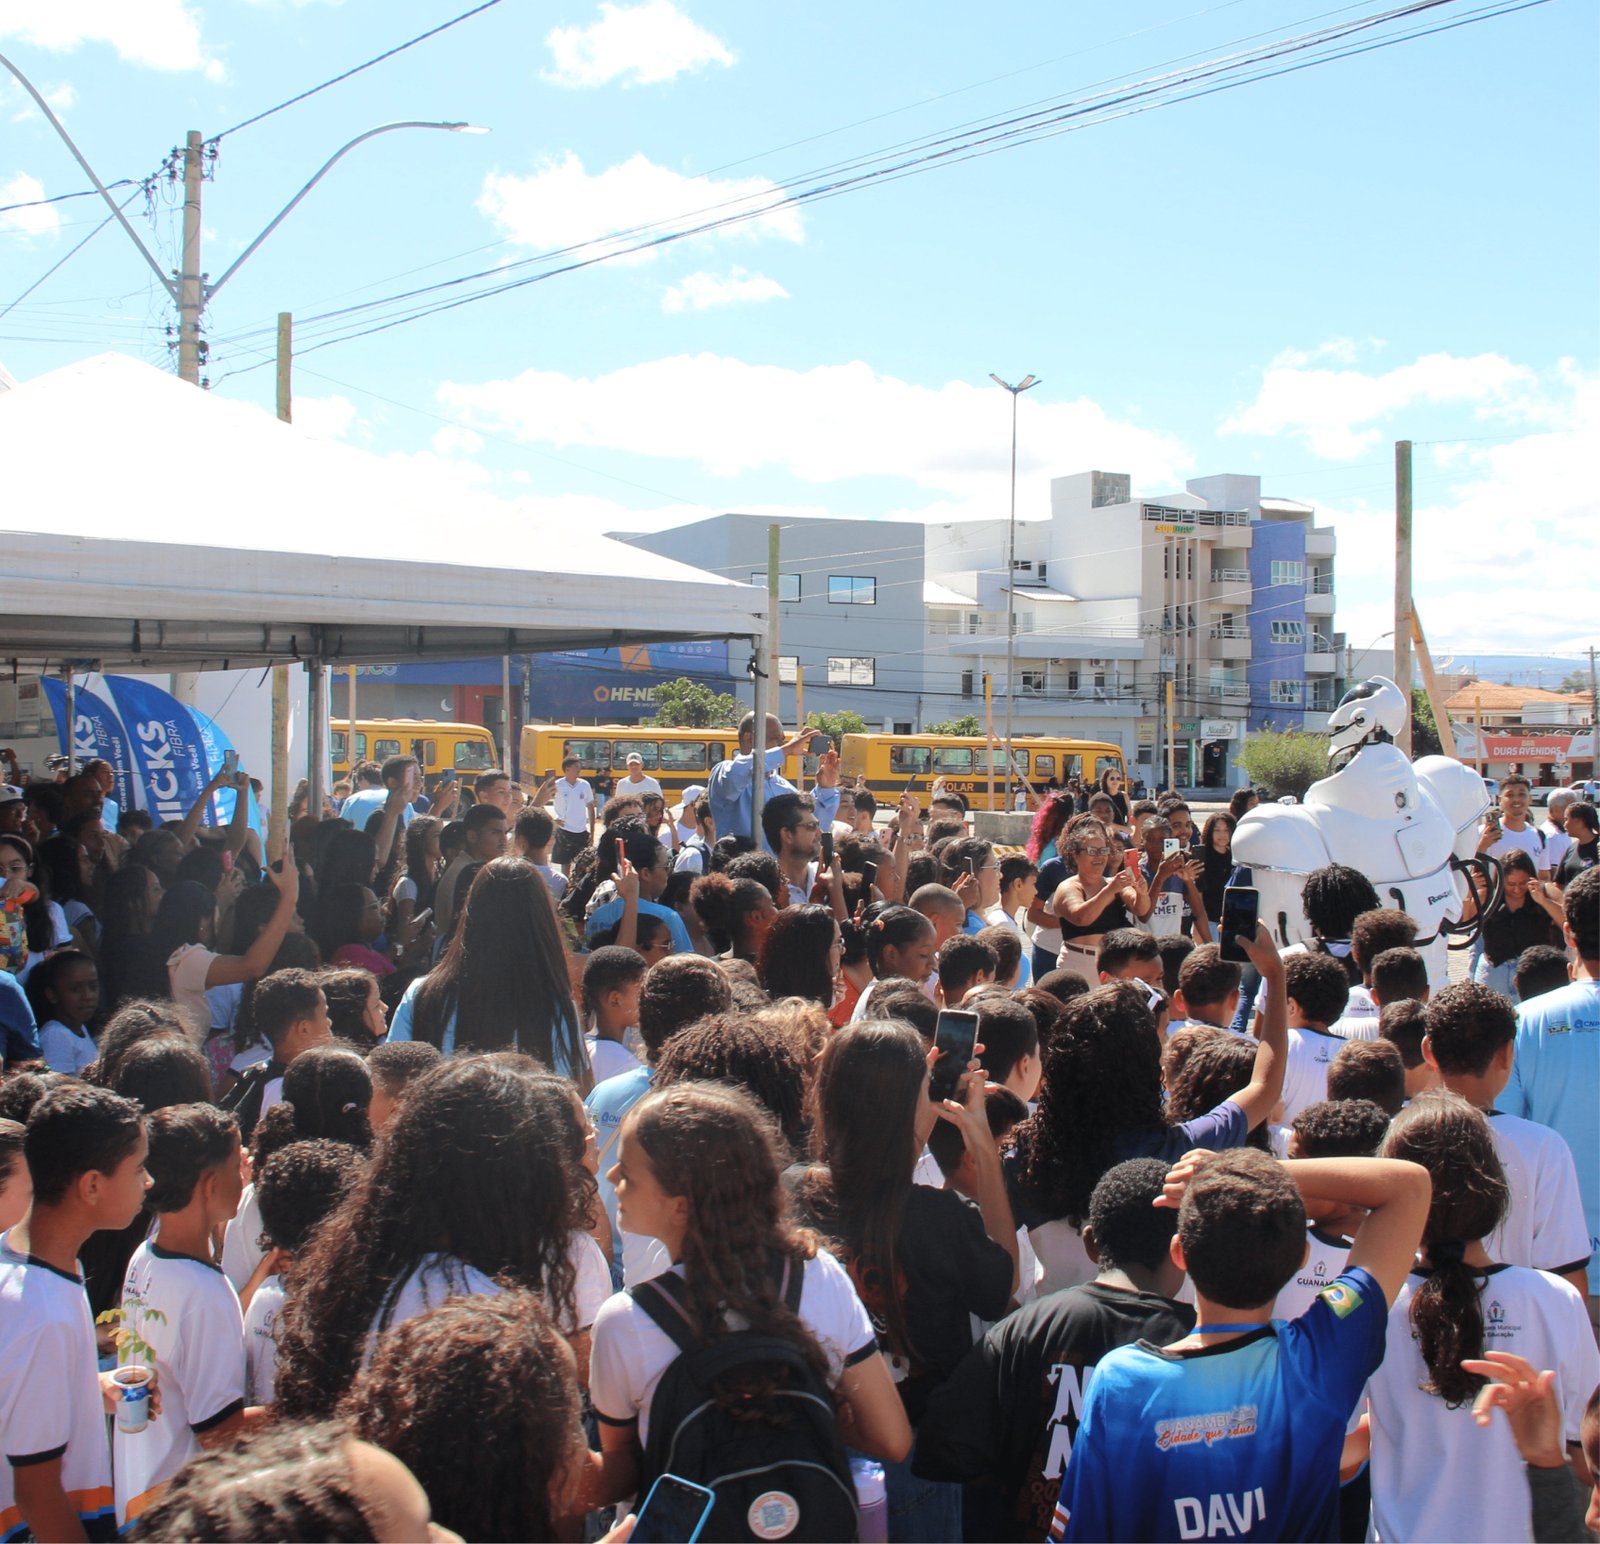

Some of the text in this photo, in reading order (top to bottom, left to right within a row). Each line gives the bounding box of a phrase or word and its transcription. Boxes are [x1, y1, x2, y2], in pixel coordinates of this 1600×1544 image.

[91, 715, 109, 747] FIBRA
[165, 720, 185, 757] FIBRA
[1493, 746, 1561, 756] DUAS AVENIDAS
[926, 782, 974, 792] EOLAR
[1205, 1429, 1224, 1442] que
[1173, 1486, 1267, 1541] DAVI
